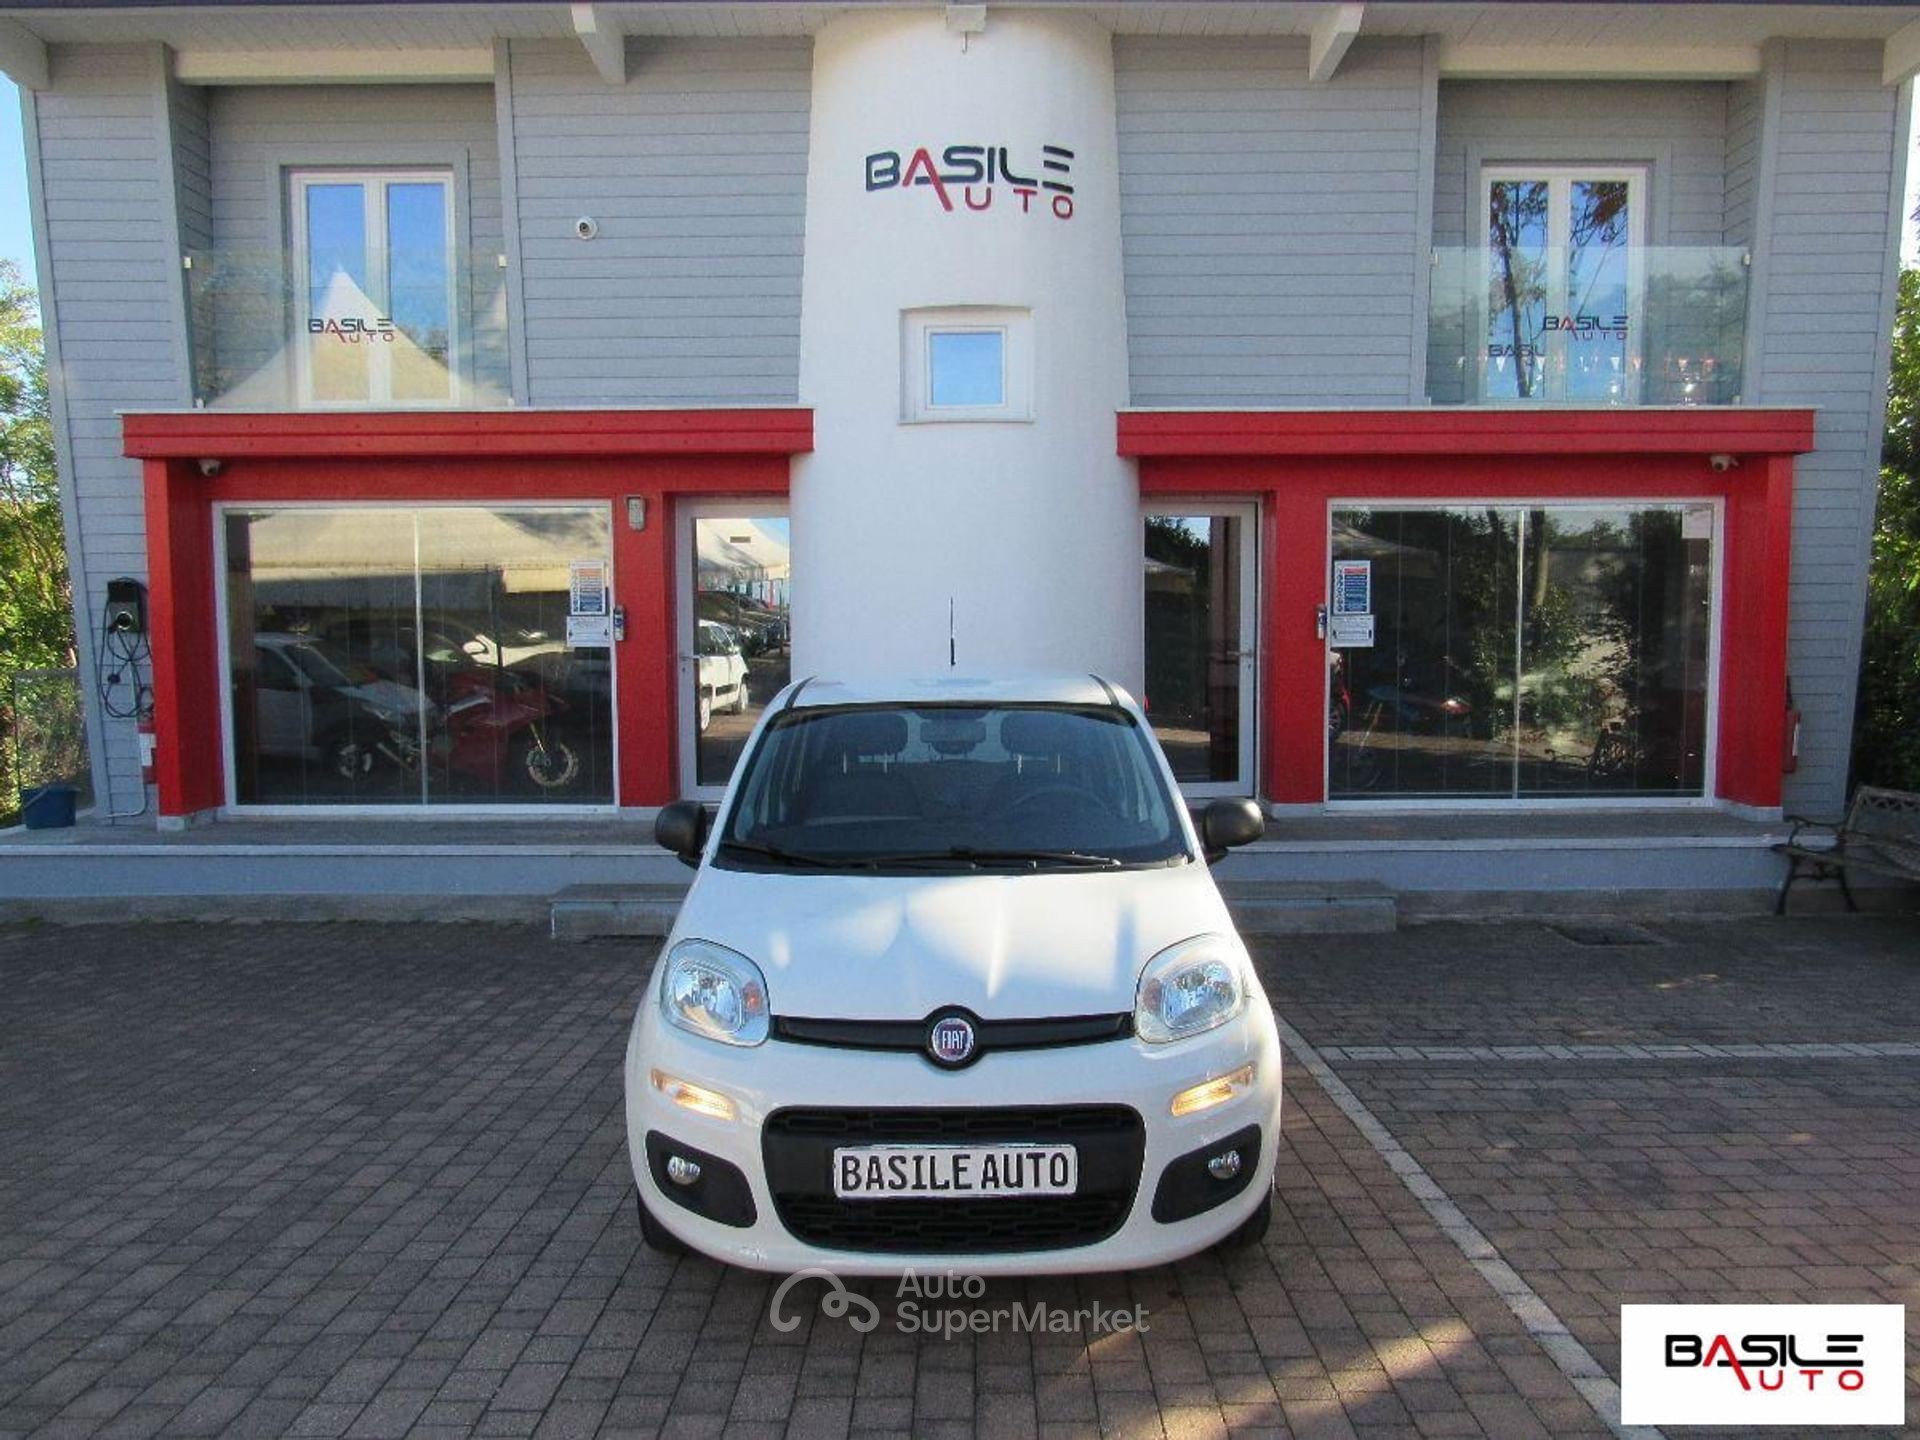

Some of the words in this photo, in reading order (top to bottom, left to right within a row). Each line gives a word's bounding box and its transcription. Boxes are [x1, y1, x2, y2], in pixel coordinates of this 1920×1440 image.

[866, 145, 1075, 196] BASILE
[308, 318, 394, 333] BASILE
[1543, 316, 1628, 331] BASILE
[942, 1030, 966, 1049] FIAT
[841, 1154, 973, 1192] BASILE
[980, 1152, 1069, 1190] AUTO
